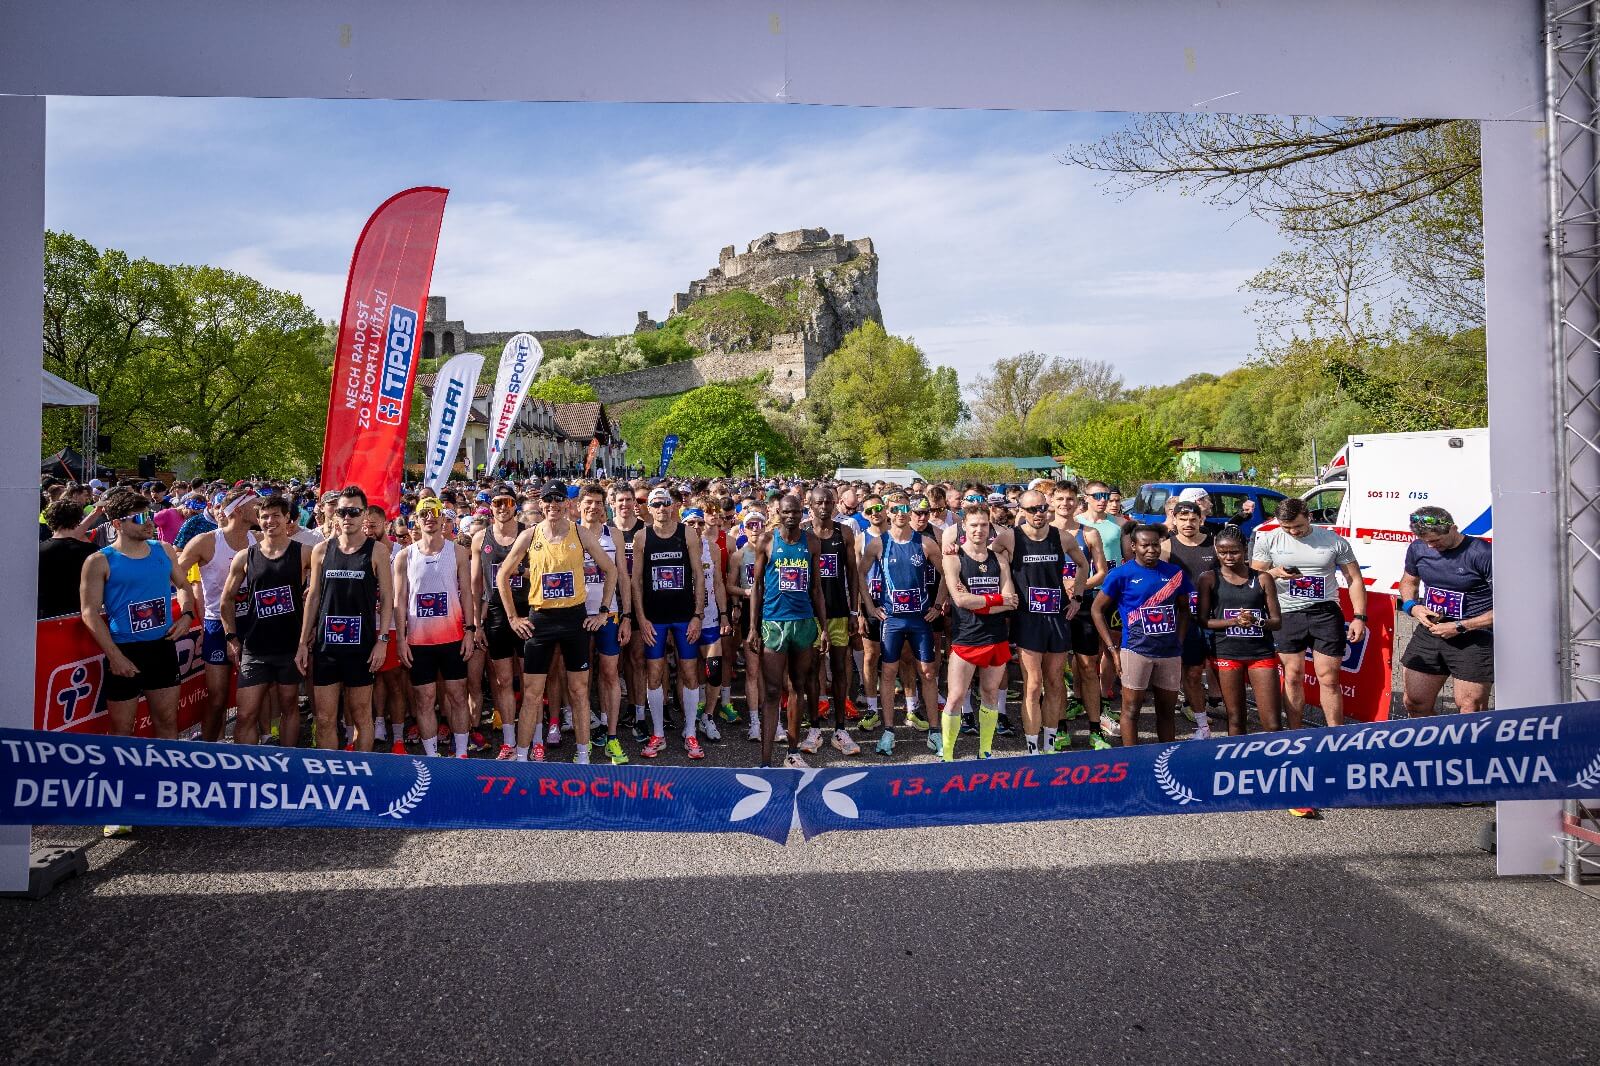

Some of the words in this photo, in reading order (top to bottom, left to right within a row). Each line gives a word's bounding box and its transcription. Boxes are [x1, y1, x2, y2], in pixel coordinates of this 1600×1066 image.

[370, 288, 388, 338] VÍŤAZÍ
[352, 301, 370, 363] RADOSŤ
[385, 313, 412, 391] TIPOS
[359, 342, 380, 404] ŠPORTU
[346, 367, 360, 409] NECH
[496, 343, 528, 438] INTERSPORT
[358, 408, 371, 430] ZO
[1368, 490, 1383, 498] SOS
[1413, 492, 1428, 500] 155
[544, 589, 566, 598] 5501
[781, 581, 796, 589] 992
[1291, 588, 1314, 598] 1238
[260, 604, 284, 616] 1019
[419, 608, 434, 616] 176
[894, 604, 910, 612] 362
[1031, 602, 1046, 611] 791
[133, 619, 153, 630] 761
[1146, 623, 1168, 632] 1117
[326, 634, 344, 642] 106
[1214, 736, 1312, 760] TIPOS
[1316, 717, 1492, 752] NÁRODNÝ
[1496, 716, 1564, 742] BEH
[2, 739, 106, 766] TIPOS
[115, 744, 290, 773] NÁRODNÝ
[303, 758, 373, 776] BEH
[888, 777, 932, 796] 13.
[941, 766, 1040, 794] APRÍL
[1050, 762, 1130, 786] 2025
[1213, 760, 1315, 796] DEVÍN
[1346, 756, 1557, 790] BRATISLAVA
[14, 772, 124, 808] DEVÍN
[157, 781, 370, 811] BRATISLAVA
[476, 776, 528, 796] 77.
[538, 776, 674, 800] ROČNÍK
